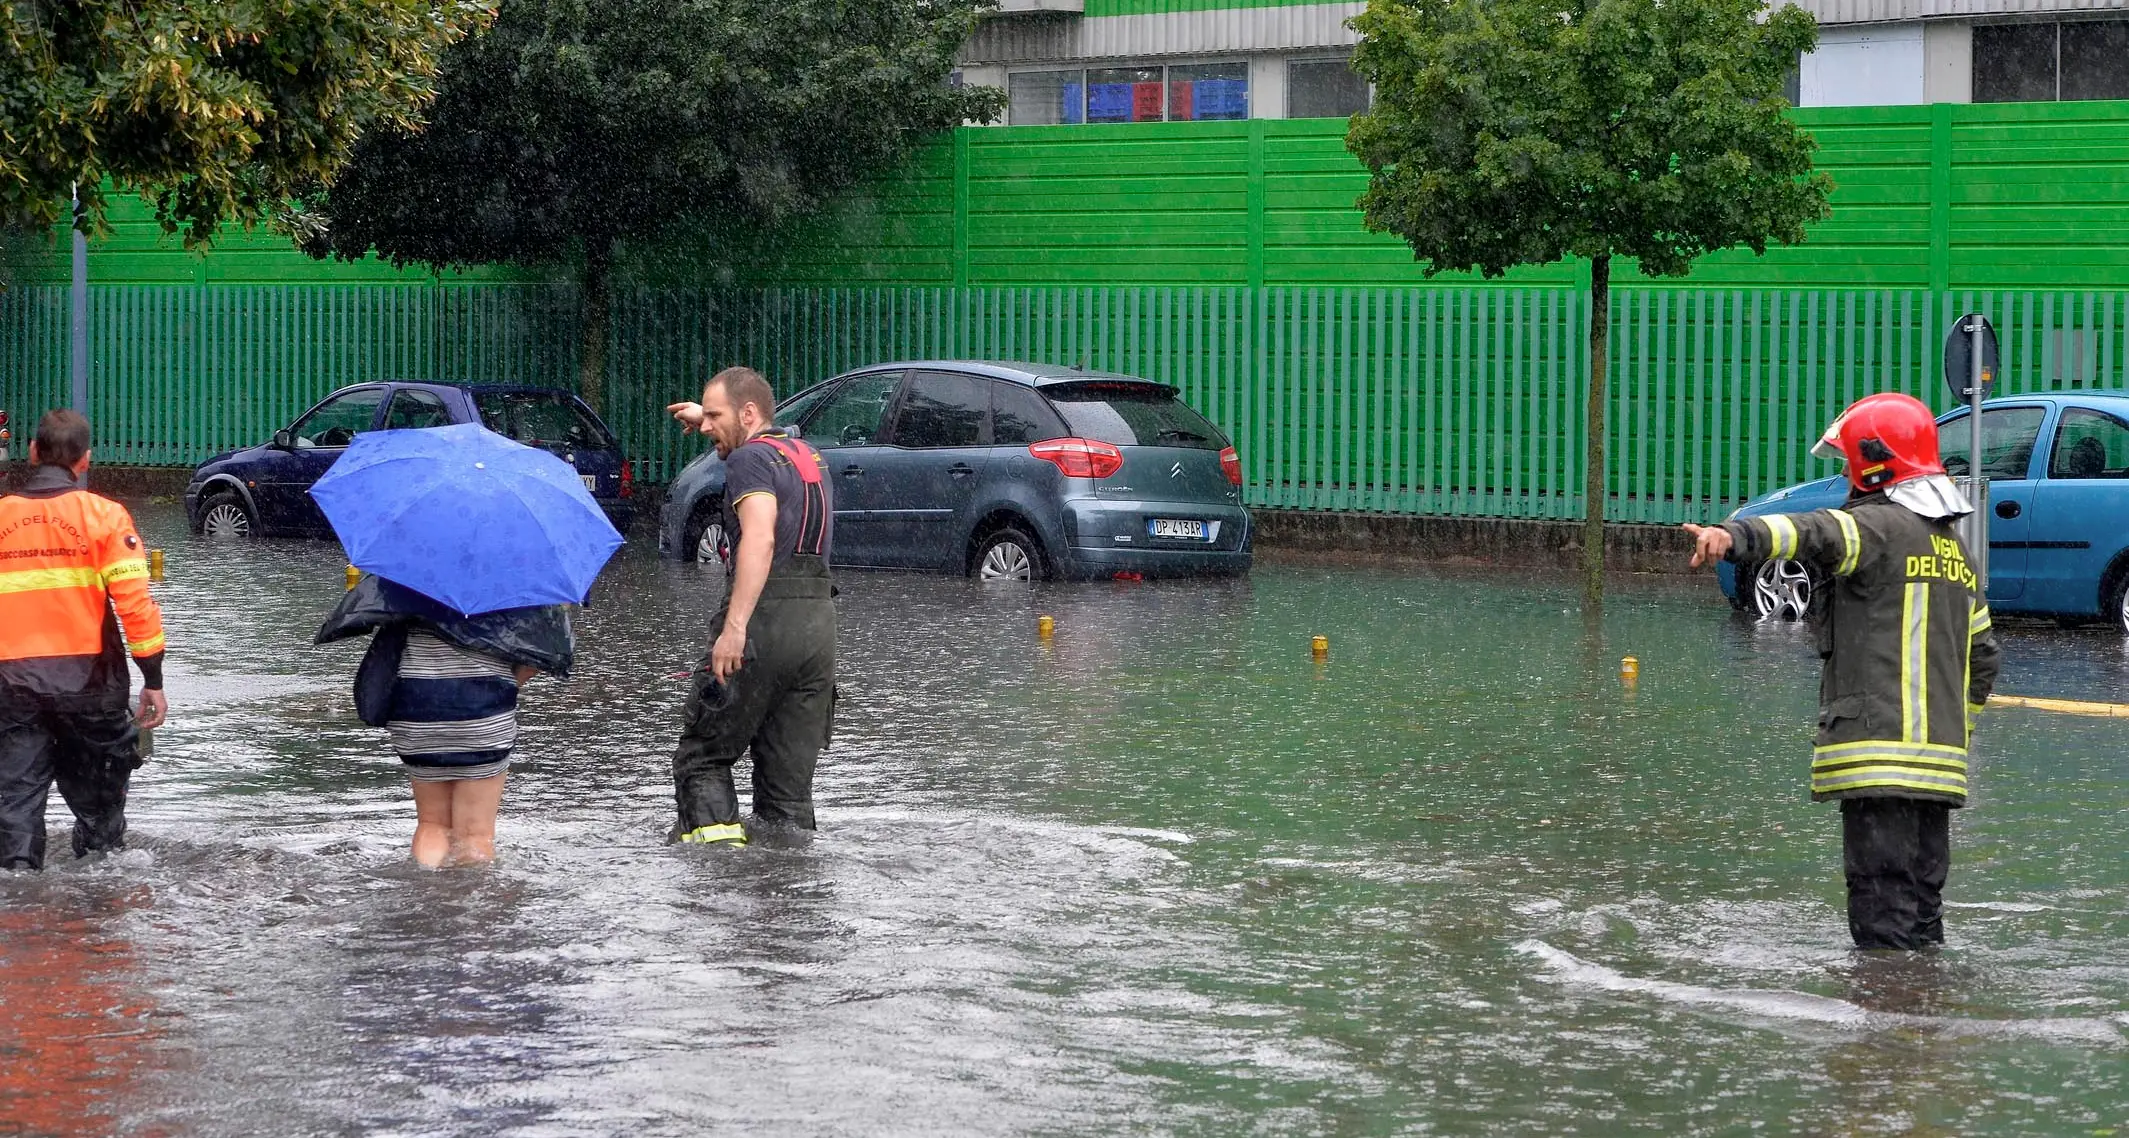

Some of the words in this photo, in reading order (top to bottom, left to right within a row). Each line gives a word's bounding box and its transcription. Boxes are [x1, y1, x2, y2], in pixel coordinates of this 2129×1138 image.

[22, 515, 48, 526] DEL
[1155, 520, 1168, 534] DP
[1172, 520, 1202, 536] 413AR
[1905, 555, 1941, 577] DEL
